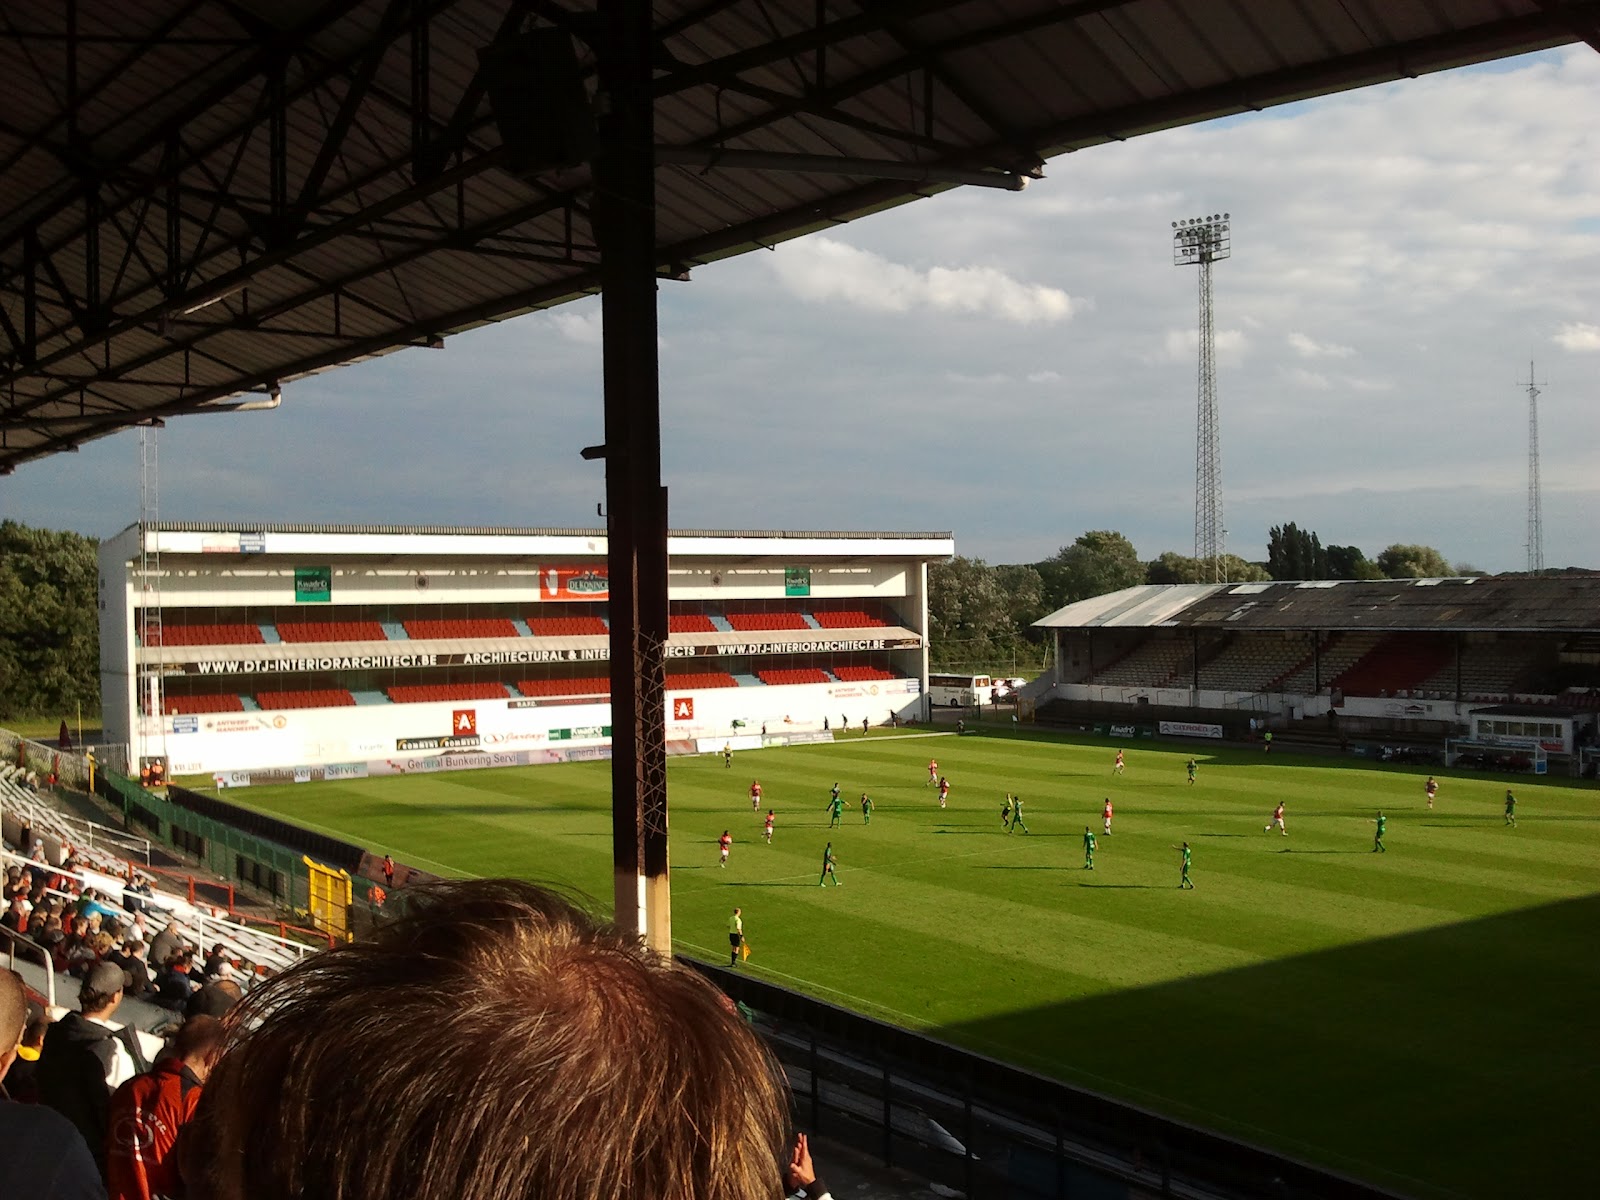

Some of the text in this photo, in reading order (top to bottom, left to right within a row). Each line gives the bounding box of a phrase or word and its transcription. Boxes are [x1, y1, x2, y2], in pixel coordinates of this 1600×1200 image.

[463, 651, 564, 664] ARCHITECTURAL
[568, 650, 577, 660] &
[664, 646, 695, 656] JECTS
[717, 640, 885, 655] WWW.DTJ-INTERIORARCHITECT.BE
[197, 655, 437, 674] WWW.DTJ-INTERIORARCHITECT.BE
[408, 758, 443, 769] General
[446, 754, 491, 767] Bunkering
[231, 769, 271, 782] General
